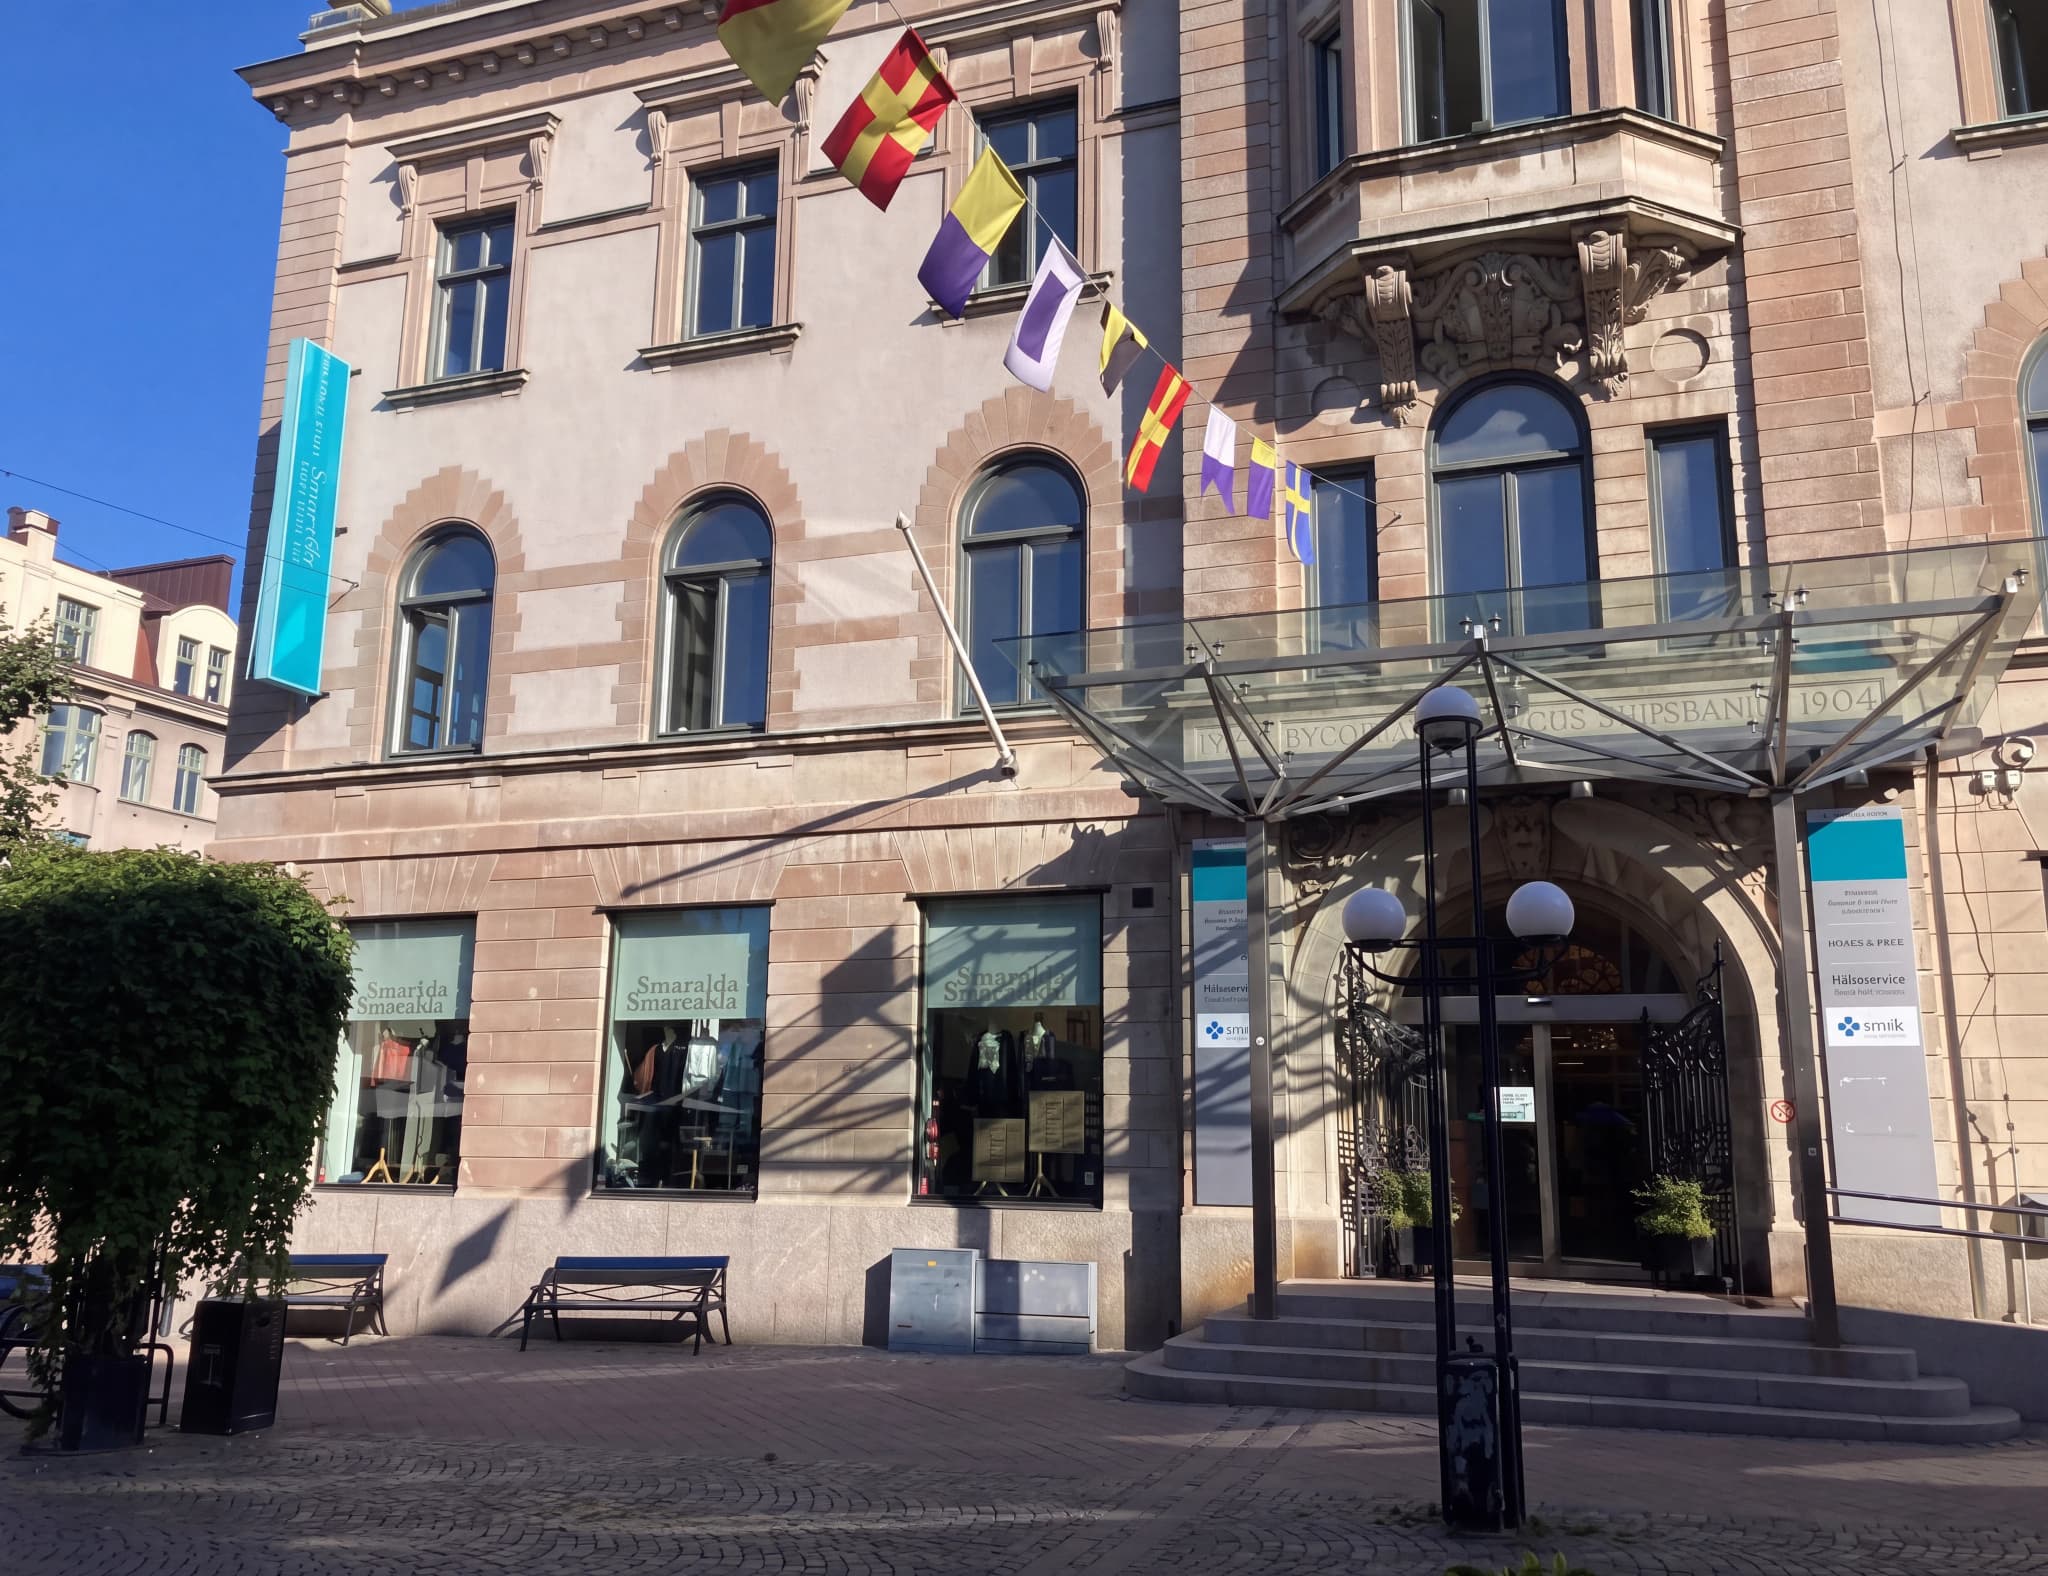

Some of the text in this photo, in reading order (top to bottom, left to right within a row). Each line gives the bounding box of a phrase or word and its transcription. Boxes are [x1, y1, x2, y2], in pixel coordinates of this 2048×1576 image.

[1801, 685, 1878, 716] 1904
[1866, 939, 1875, 947] &
[637, 973, 739, 994] Smaralda
[1832, 973, 1906, 985] Hälsoservice
